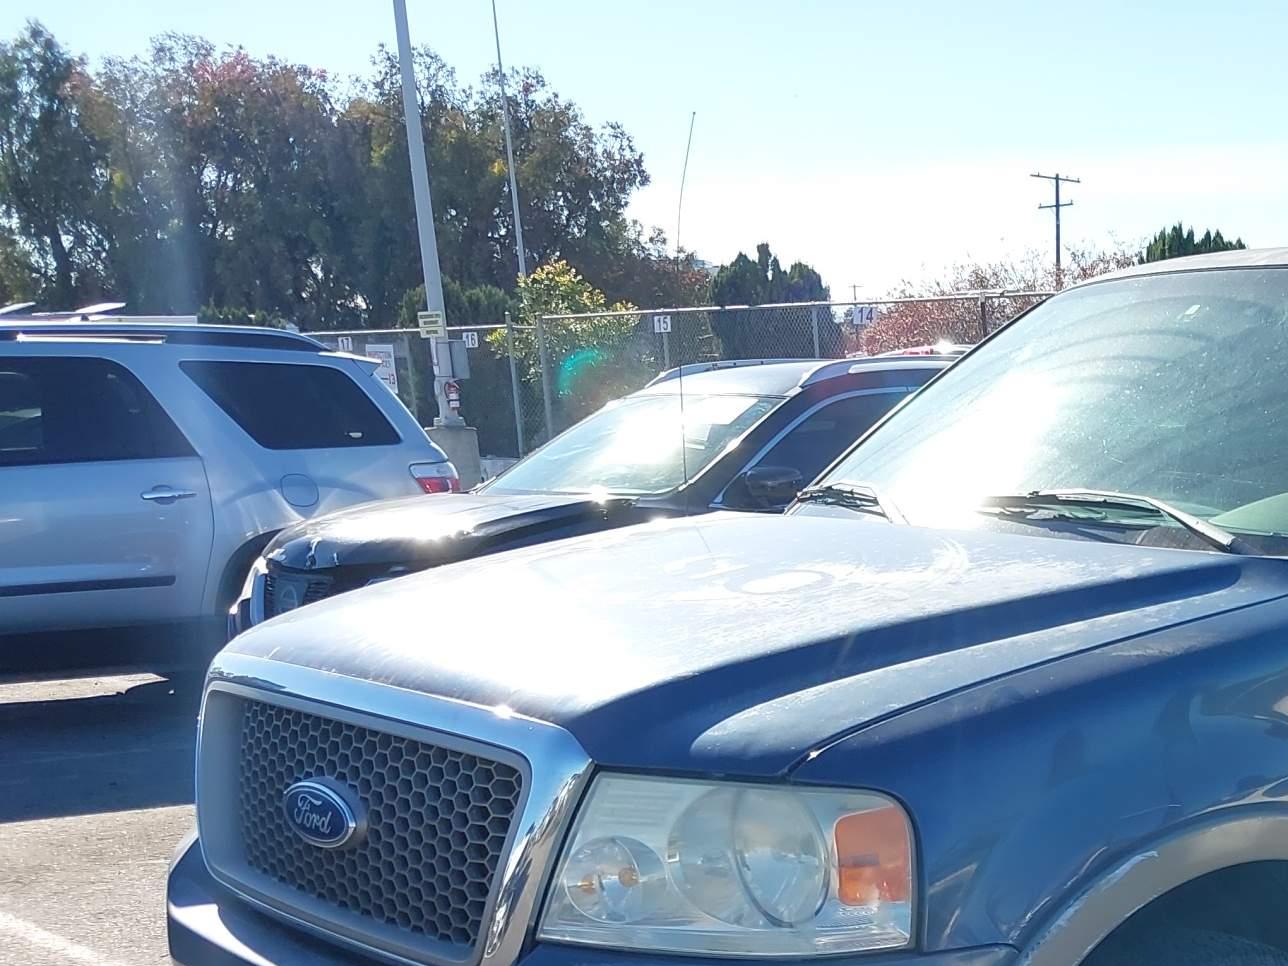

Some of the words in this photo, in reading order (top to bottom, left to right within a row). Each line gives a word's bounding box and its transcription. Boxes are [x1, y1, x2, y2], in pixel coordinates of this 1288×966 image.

[858, 306, 873, 323] 14
[656, 316, 669, 331] 15
[341, 337, 350, 350] 17
[465, 333, 476, 347] 16
[294, 794, 332, 834] Ford
